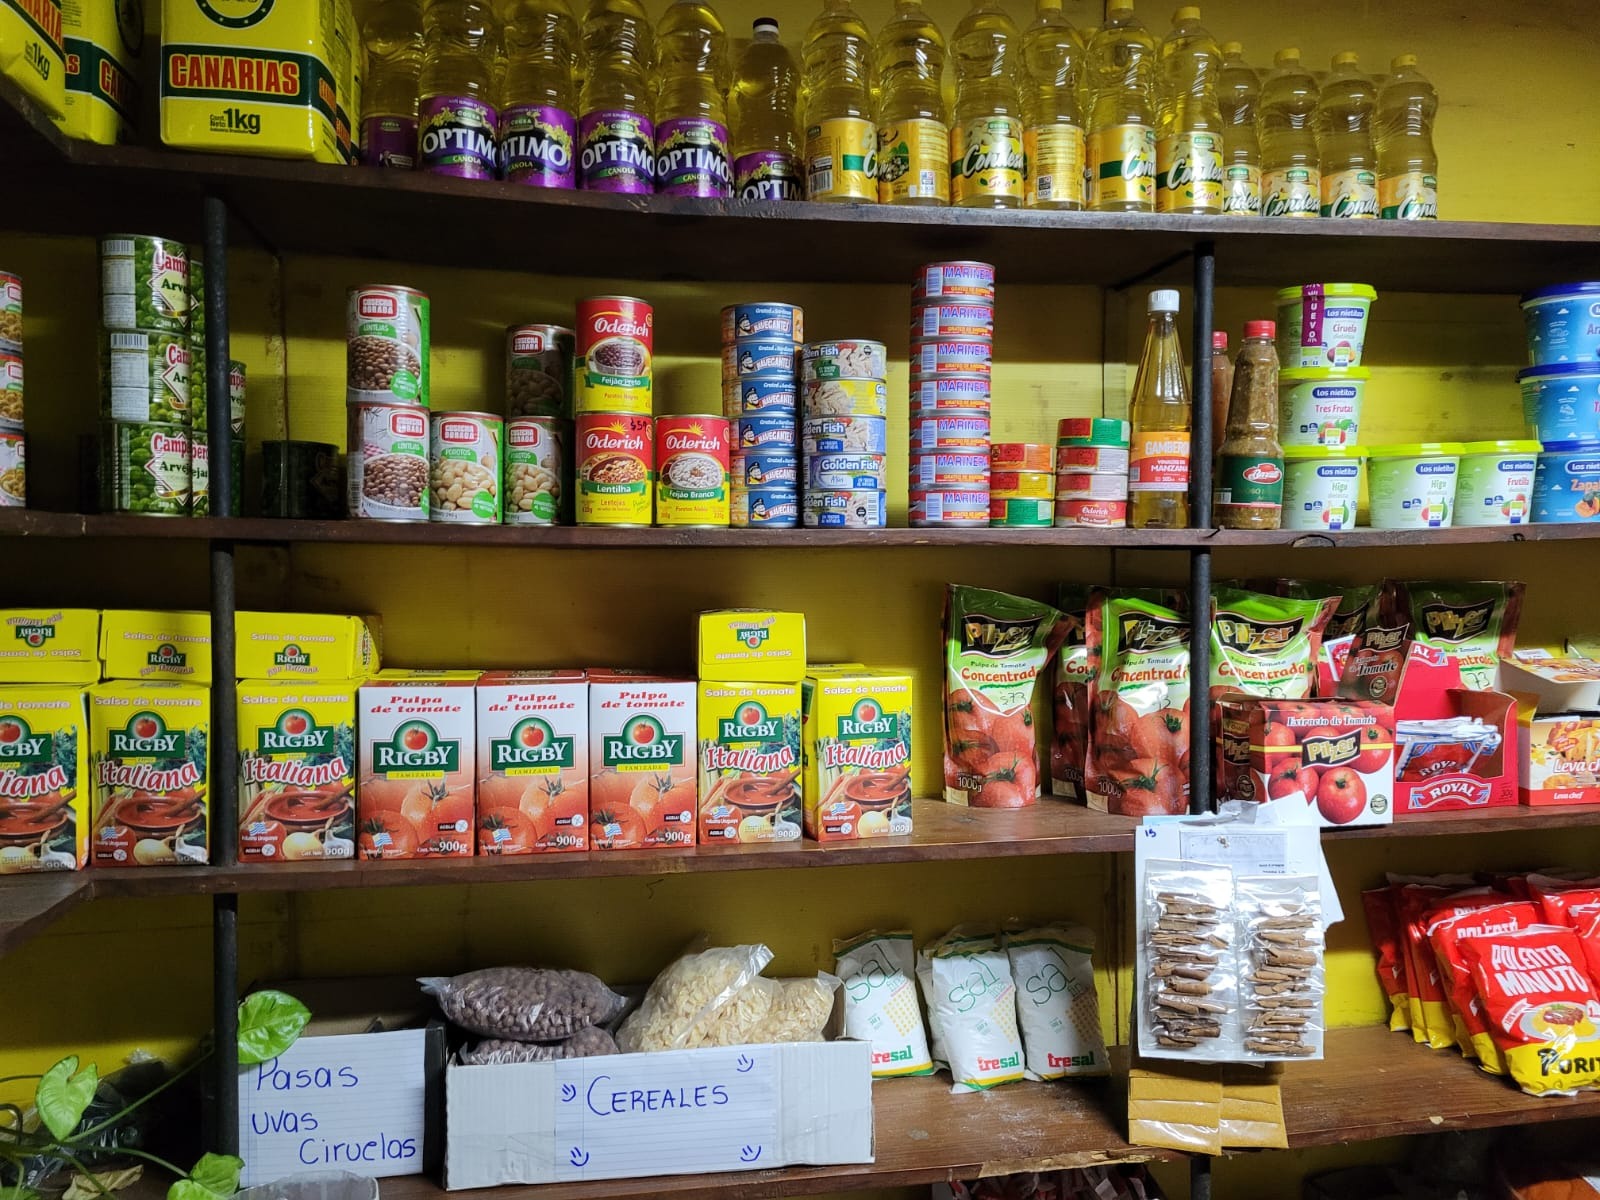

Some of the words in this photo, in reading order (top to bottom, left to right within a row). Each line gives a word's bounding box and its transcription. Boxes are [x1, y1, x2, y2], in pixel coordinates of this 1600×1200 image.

[169, 54, 300, 95] CANARIAS
[223, 107, 261, 135] 1kg
[453, 155, 481, 164] CANOLA
[608, 167, 636, 175] CANOLA
[682, 174, 710, 182] CANOLA
[155, 250, 189, 278] Camp
[594, 317, 649, 337] Oderich
[1333, 323, 1357, 333] Ciruela
[820, 345, 839, 356] Fish
[1315, 405, 1331, 413] Tres
[1332, 404, 1353, 413] Frutas
[823, 421, 844, 433] Fish
[154, 434, 190, 458] Camp
[586, 433, 644, 450] Oderich
[666, 434, 721, 450] Oderich
[821, 458, 860, 470] Golden
[860, 459, 879, 470] Fish
[1571, 462, 1585, 470] Los
[597, 482, 632, 493] Lentilha
[1570, 479, 1600, 493] Zapa
[669, 490, 689, 499] Feijão
[690, 490, 715, 498] Branco
[824, 496, 846, 507] Fish
[123, 632, 153, 641] Salsa
[157, 632, 170, 641] de
[251, 633, 280, 641] Salsa
[150, 652, 183, 664] RIGBY
[277, 652, 308, 664] RIGBY
[1458, 654, 1494, 667] entrado
[961, 665, 1037, 682] Concentrad
[1111, 664, 1187, 682] Cncentrad
[1356, 661, 1399, 677] Tomate
[1467, 671, 1490, 690] 73
[507, 693, 557, 702] Pulpa
[619, 691, 668, 700] Pulpa
[705, 688, 736, 697] Salsa
[739, 688, 754, 696] de
[756, 688, 796, 696] tomate
[823, 686, 852, 695] Salsa
[855, 686, 869, 694] de
[871, 685, 908, 693] tomate
[17, 701, 71, 710] tomate
[95, 697, 129, 706] Salsa
[133, 697, 149, 706] de
[154, 697, 202, 707] tomate
[242, 695, 278, 704] Salsa
[282, 695, 298, 703] de
[302, 695, 349, 703] tomate
[390, 695, 442, 704] Pulpa
[488, 703, 508, 712] de
[515, 702, 575, 711] tomate
[626, 700, 685, 708] tomate
[370, 705, 392, 713] de
[397, 705, 462, 713] tomate
[723, 718, 778, 738] RIGBY
[841, 716, 893, 736] RIGBY
[1286, 716, 1329, 727] Extracto
[1330, 716, 1342, 726] de
[1343, 715, 1377, 726] Tomate
[0, 736, 46, 757] GBY
[114, 733, 180, 752] RIGBY
[263, 729, 328, 749] RIGBY
[379, 745, 451, 767] RIGBY
[497, 741, 568, 763] RIGBY
[609, 739, 678, 760] RIGBY
[825, 741, 907, 769] Italiana
[1307, 737, 1357, 764] Pilzer
[706, 745, 794, 772] Italiana
[1553, 758, 1586, 774] Leva
[97, 760, 201, 791] Italiana
[244, 757, 348, 786] Italiana
[957, 775, 982, 793] 1000g
[1429, 782, 1476, 799] ROYAL
[1569, 791, 1585, 799] chef
[556, 835, 584, 848] 900g
[665, 831, 691, 844] 900g
[439, 840, 468, 853] 900g
[1491, 944, 1572, 971] POLENTA
[1026, 946, 1076, 1007] sal
[1494, 965, 1590, 997] MINUTO
[948, 956, 1000, 1014] sal
[977, 1052, 1020, 1072] tresal
[1048, 1052, 1096, 1069] tresal
[257, 1056, 359, 1091] Pasas
[586, 1075, 729, 1116] CEREALES
[299, 1132, 416, 1165] Ciruelas
